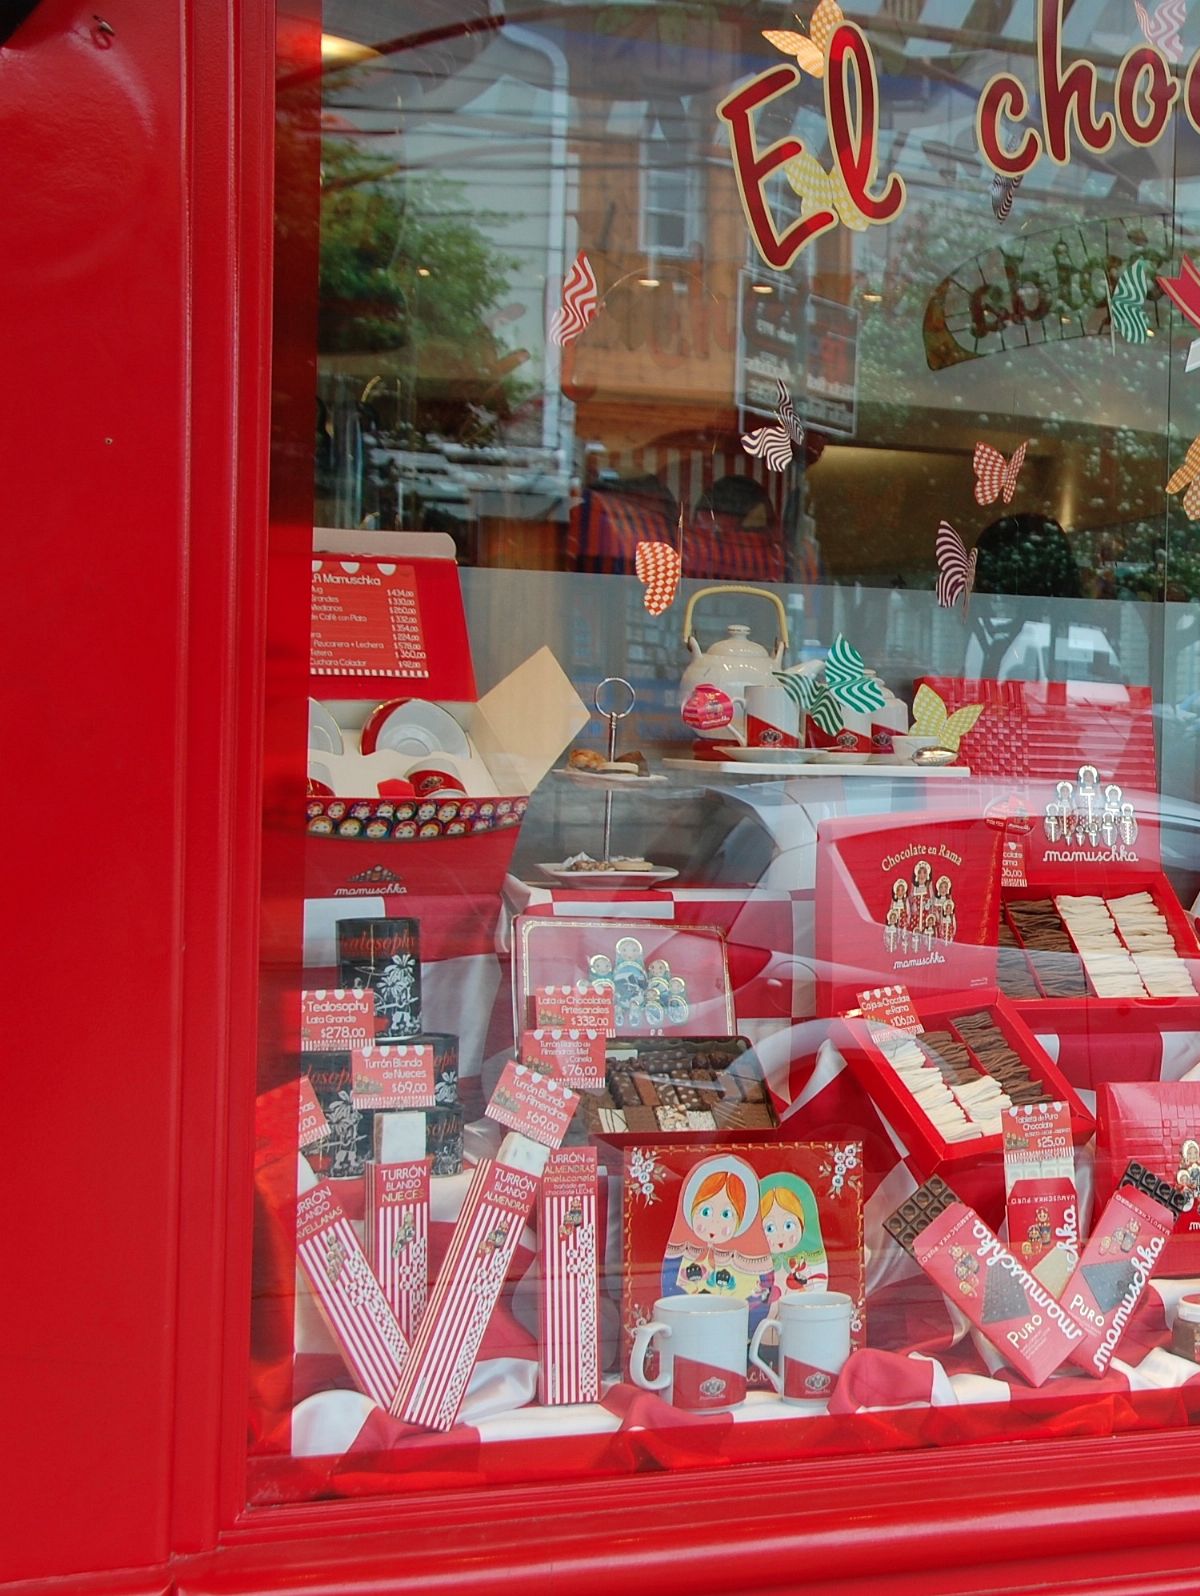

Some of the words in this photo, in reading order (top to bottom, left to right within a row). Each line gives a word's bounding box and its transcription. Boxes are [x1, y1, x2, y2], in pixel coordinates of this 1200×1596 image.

[717, 20, 905, 271] El
[323, 574, 381, 585] Mamuschka
[882, 843, 927, 872] Chocolate
[928, 846, 937, 855] en
[938, 844, 962, 866] Rama
[1043, 845, 1139, 863] mamuschka
[334, 880, 407, 895] mamuschka
[893, 952, 945, 970] mamuschka
[364, 1058, 393, 1069] Turrón
[393, 1059, 423, 1068] Blando
[393, 1069, 427, 1079] Nueces
[551, 1152, 586, 1164] URRÓN
[381, 1165, 427, 1181] TURRÓN
[544, 1164, 595, 1174] ALMENDRAS
[385, 1178, 422, 1191] BLANDO
[494, 1167, 537, 1192] TURRÓN
[381, 1188, 425, 1202] NUECES
[494, 1181, 527, 1200] BLANDO
[483, 1191, 531, 1213] ALMENDRAS
[973, 1218, 1082, 1340] mamuschka
[1070, 1293, 1105, 1328] PURO
[1092, 1236, 1165, 1373] mamuschka
[1006, 1314, 1042, 1349] PURO
